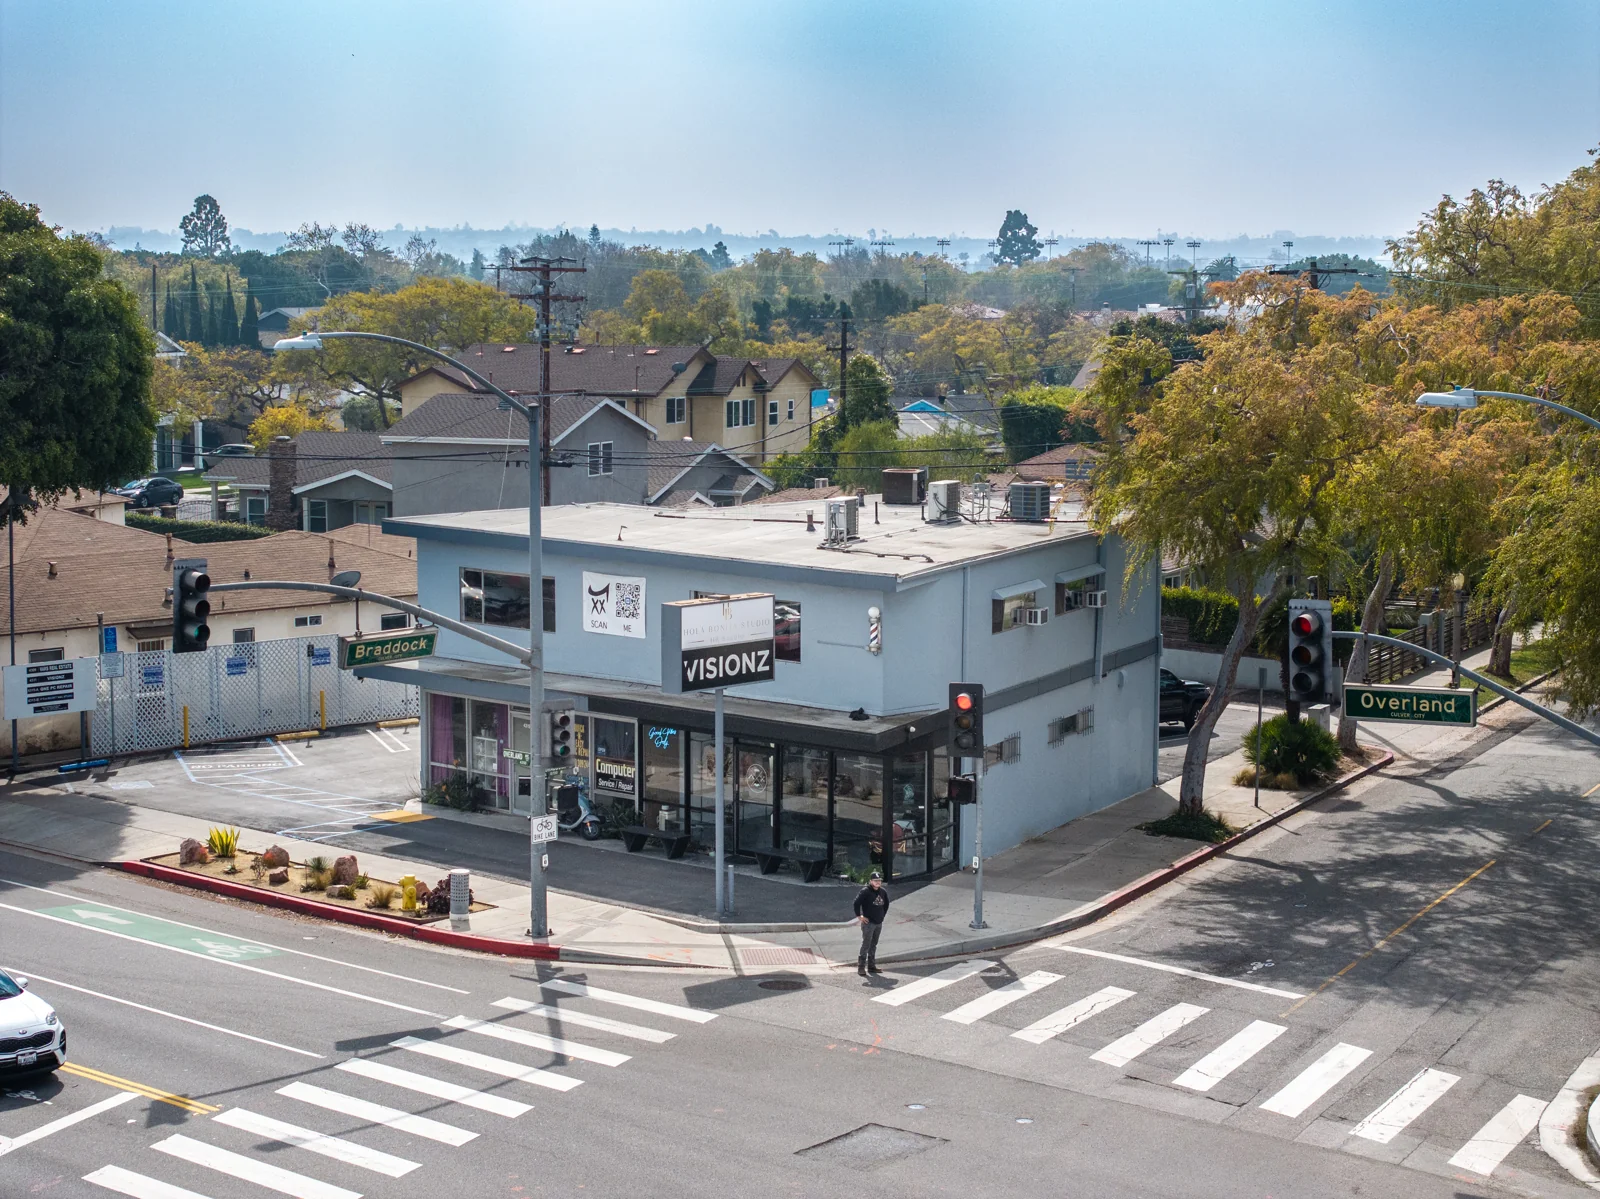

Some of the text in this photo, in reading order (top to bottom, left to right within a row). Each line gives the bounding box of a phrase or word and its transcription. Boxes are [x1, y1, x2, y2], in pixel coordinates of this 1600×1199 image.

[590, 619, 632, 633] SCAN ME
[683, 625, 705, 636] HOLA
[741, 619, 771, 629] STUDIO
[355, 637, 428, 659] Braddock
[683, 649, 770, 682] VISIONZ
[1360, 692, 1455, 713] Overland
[503, 750, 523, 760] OVERLAND
[595, 758, 636, 778] Computer
[598, 778, 614, 788] Service
[618, 781, 634, 791] Repair
[534, 830, 556, 841] BIKE LANE
